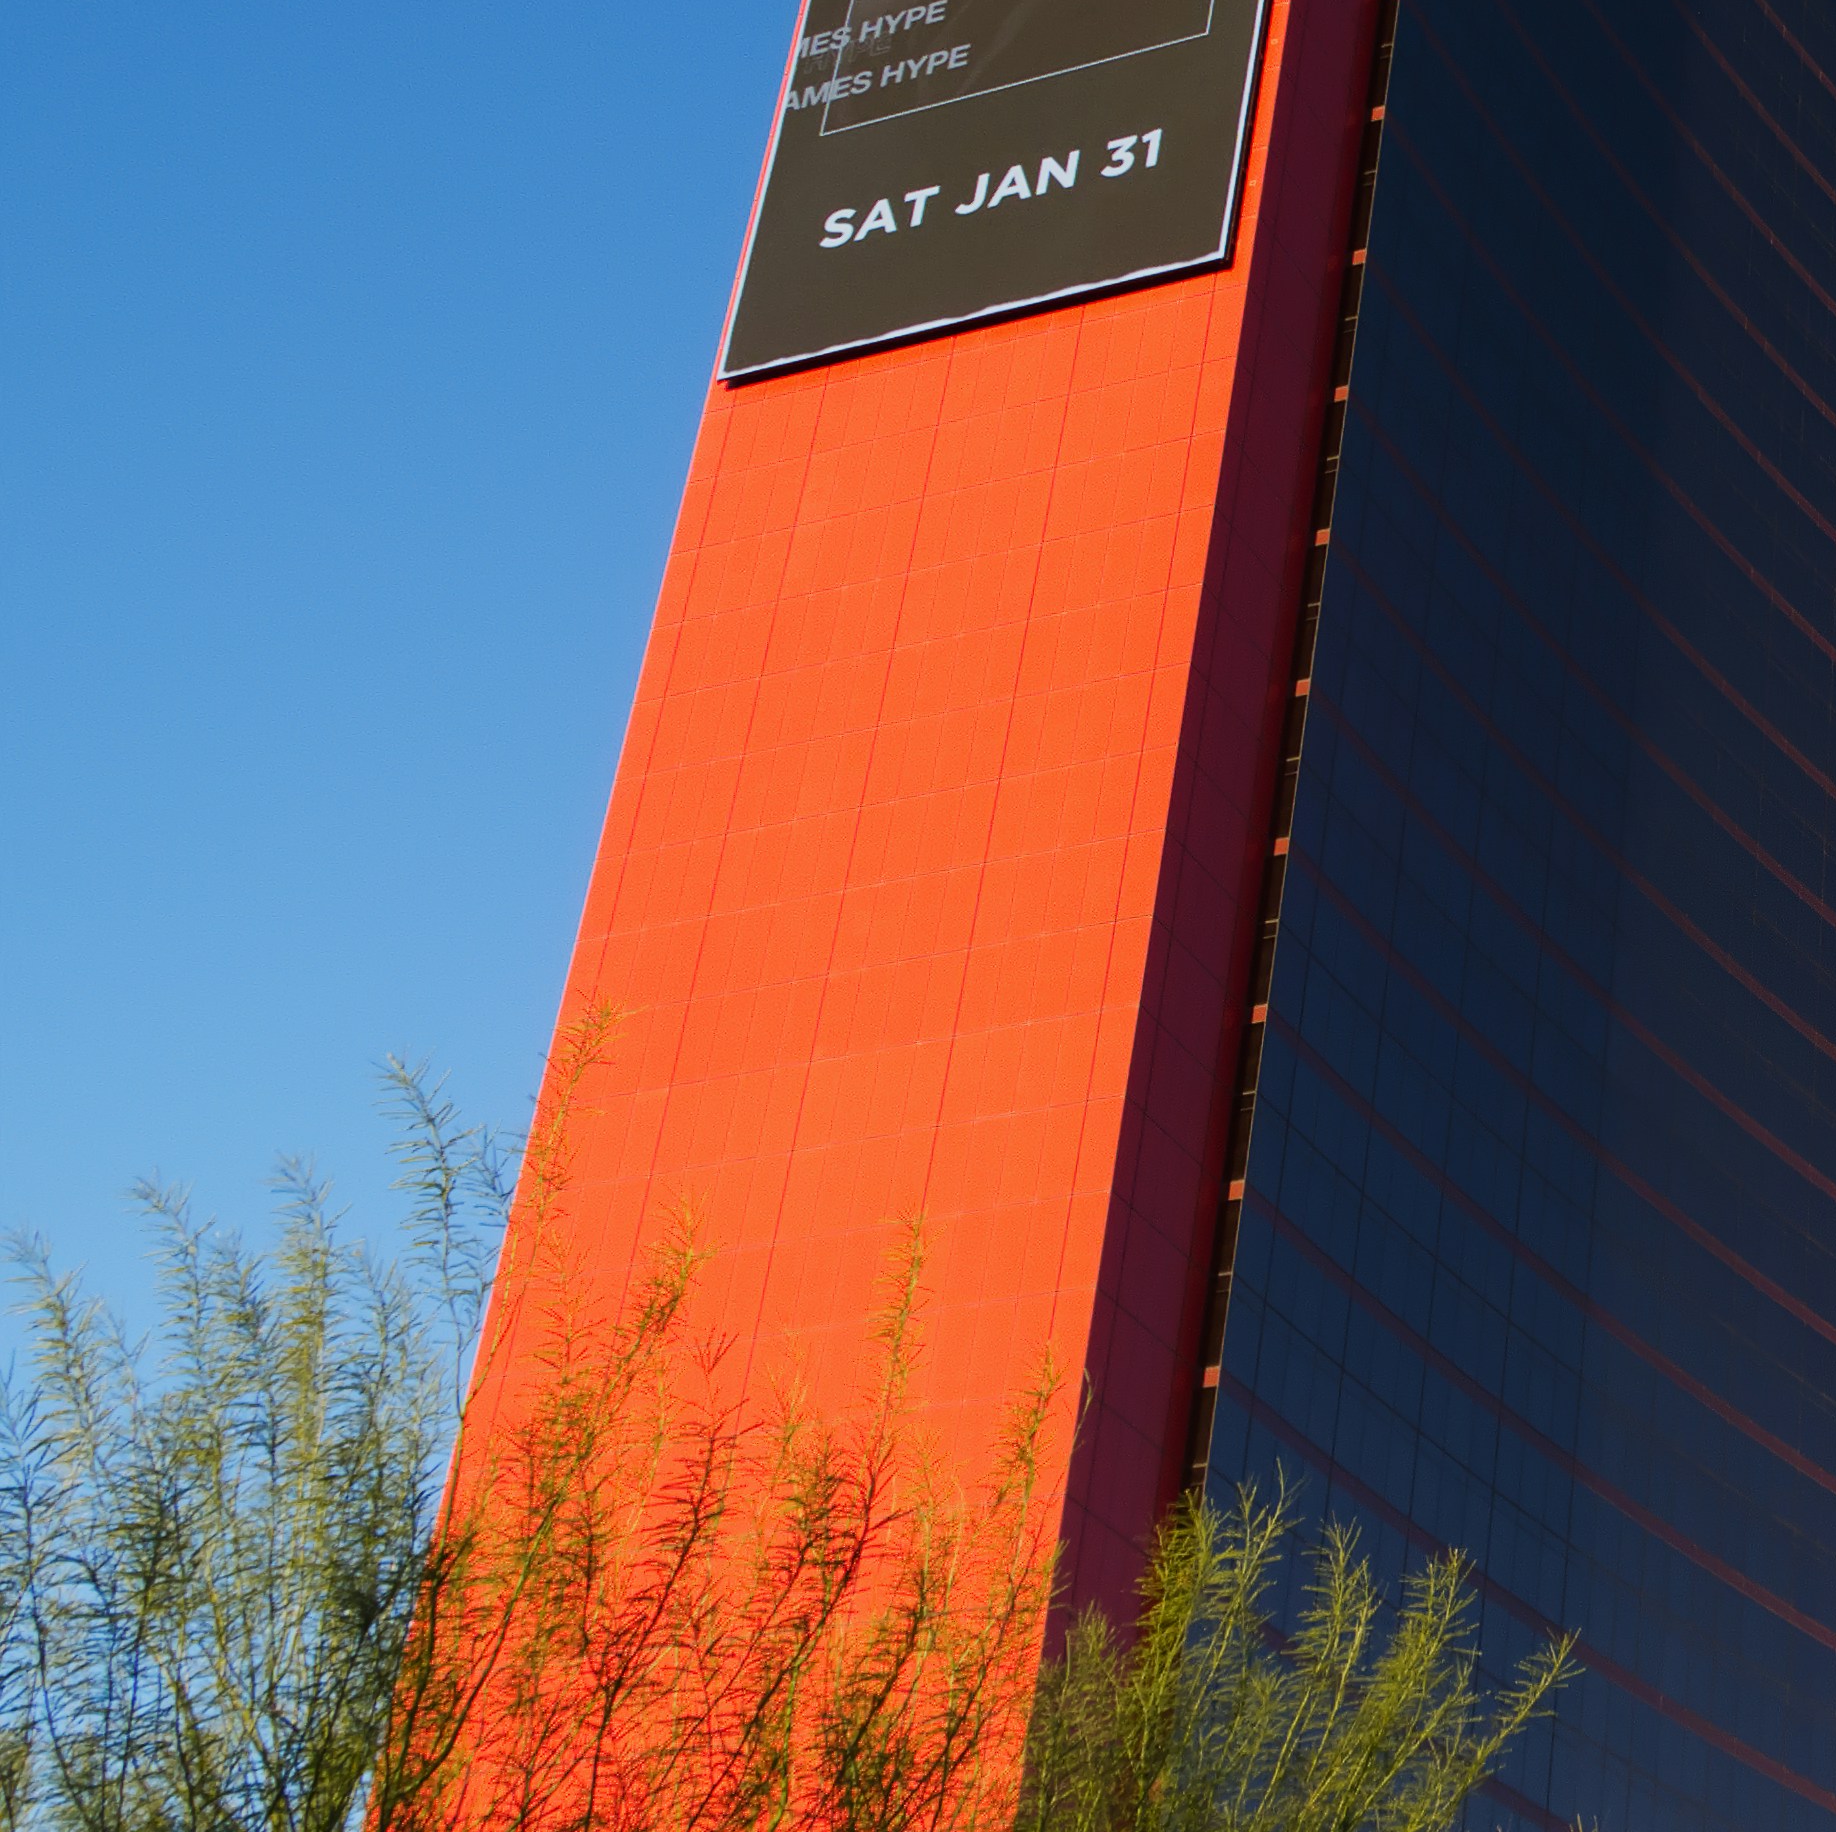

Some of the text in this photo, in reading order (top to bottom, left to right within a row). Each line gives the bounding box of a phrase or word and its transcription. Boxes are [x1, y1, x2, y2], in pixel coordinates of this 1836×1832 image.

[879, 43, 972, 88] HYPE
[818, 127, 1163, 249] SAT JAN 31
